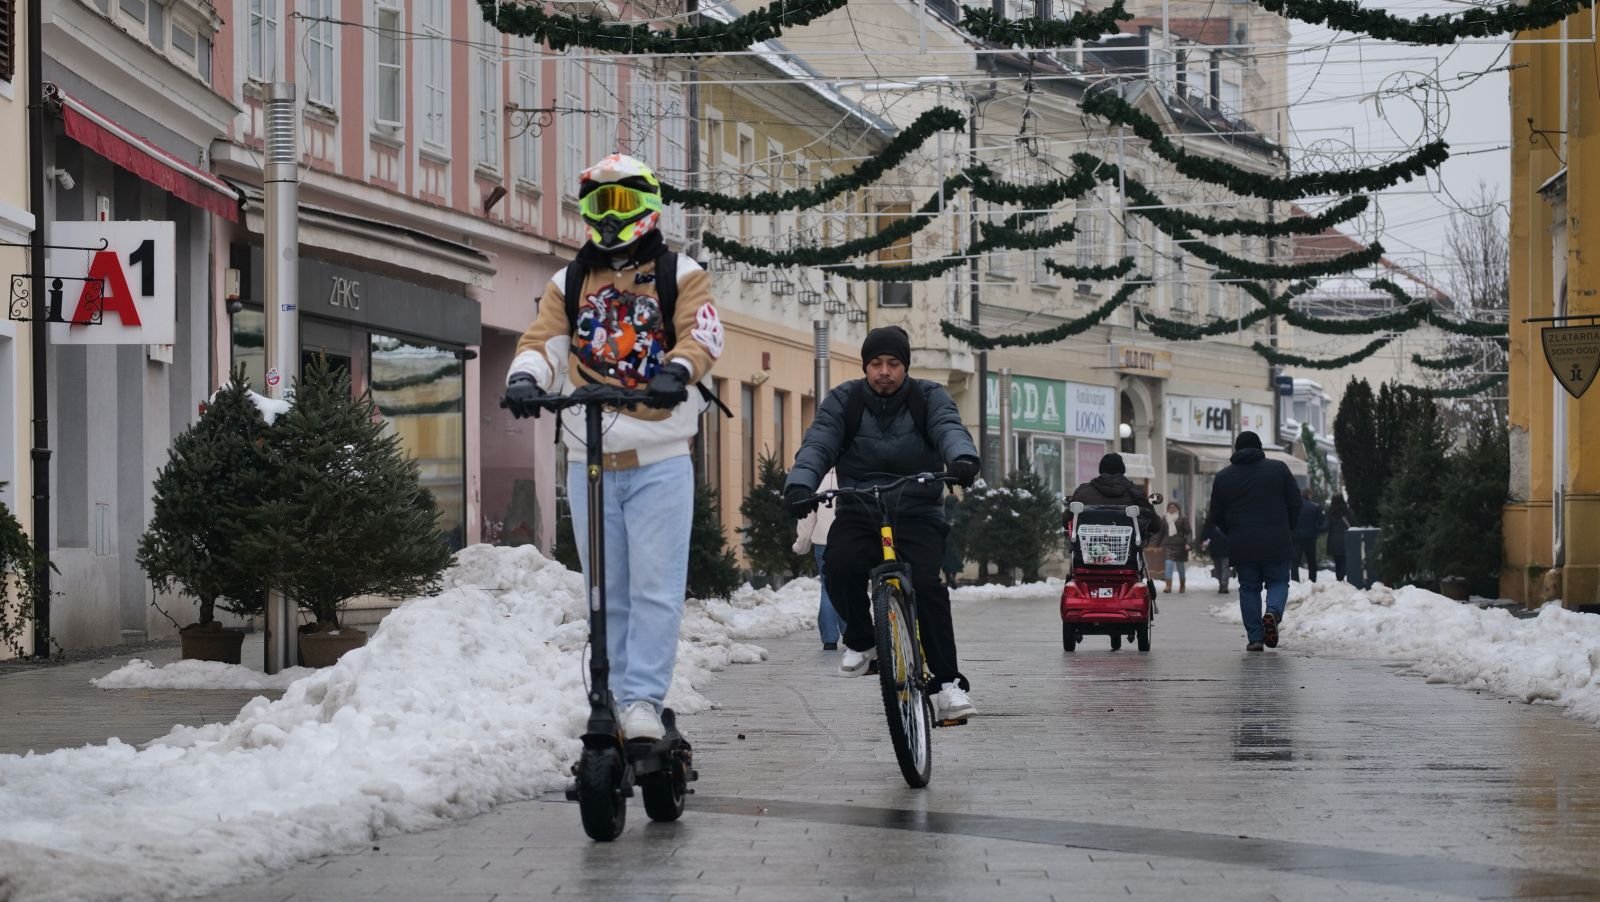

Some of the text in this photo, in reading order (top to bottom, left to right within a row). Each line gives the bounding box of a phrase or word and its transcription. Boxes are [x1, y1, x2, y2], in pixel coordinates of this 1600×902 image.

[71, 240, 155, 326] A1
[330, 276, 360, 310] ZAKS
[1576, 346, 1599, 354] GOLD
[1075, 410, 1106, 434] LOGOS
